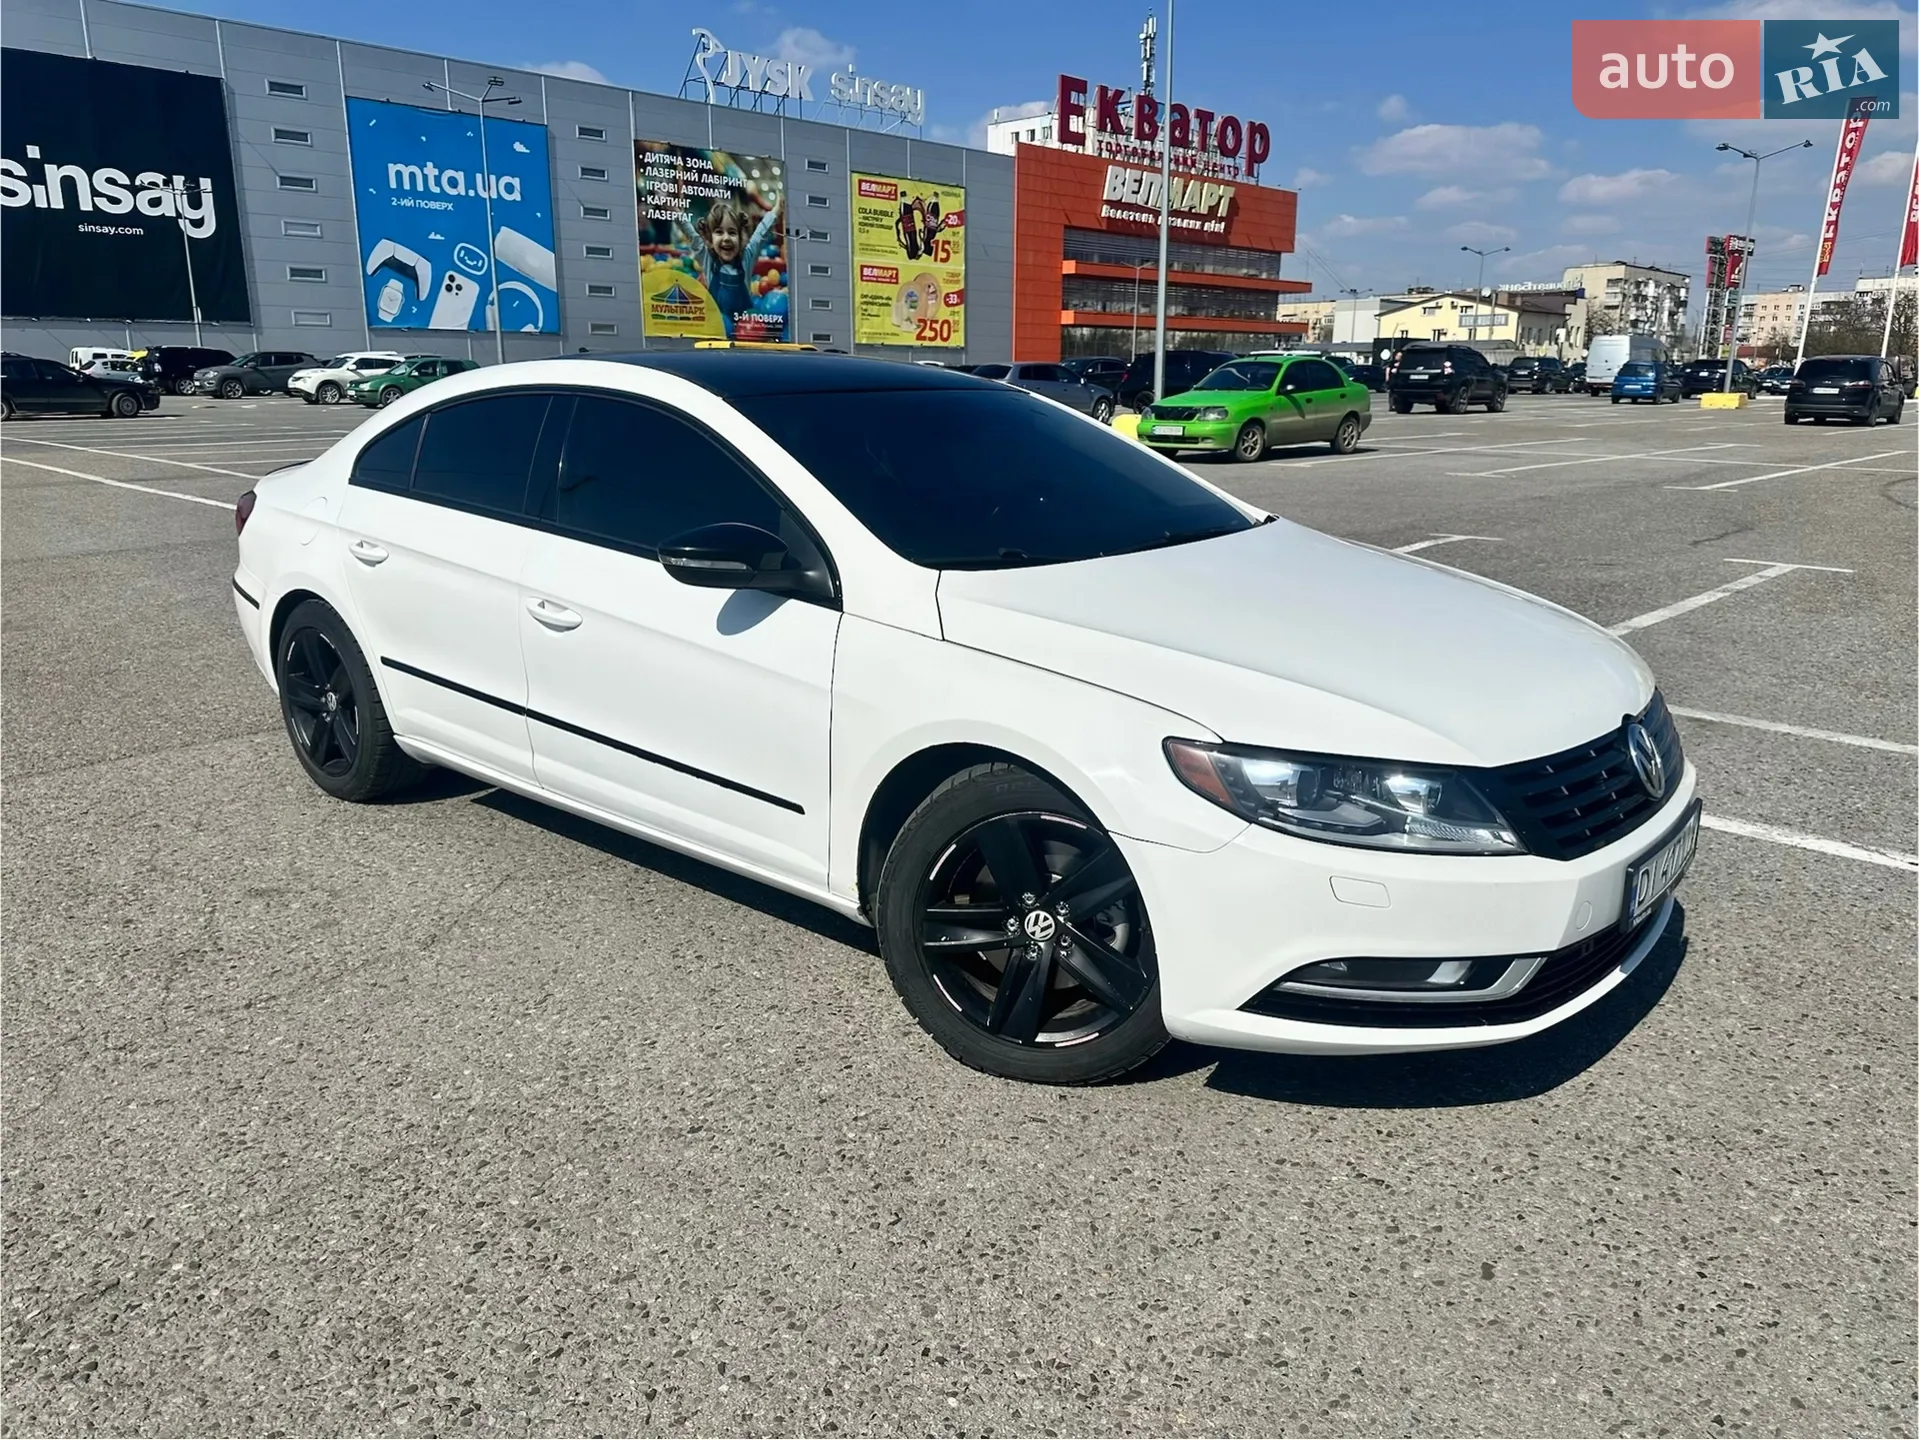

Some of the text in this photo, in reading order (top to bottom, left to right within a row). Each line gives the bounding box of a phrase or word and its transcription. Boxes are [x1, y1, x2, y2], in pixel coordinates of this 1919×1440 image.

[721, 50, 814, 102] JYSK
[830, 63, 925, 126] sinsay
[643, 151, 714, 170] ДИТЯЧА ЗОНА
[387, 161, 522, 201] mta.ua
[645, 166, 748, 188] ЛАЗЕРНИЙ ЛАБІРИНТ
[1, 145, 216, 239] sinsay
[646, 180, 731, 200] ІГРОВІ АВТОМАТИ
[1103, 164, 1236, 218] ВЕЛМАРТ
[391, 196, 454, 211] 2-ИЙ ПОВЕРХ
[647, 195, 691, 208] КАРТИНГ
[647, 209, 694, 222] ЛАЗЕРТАГ
[78, 222, 144, 236] sinsay.com
[931, 239, 951, 263] 15
[733, 310, 784, 324] 3-Й ПОВЕРХ
[916, 318, 952, 342] 250
